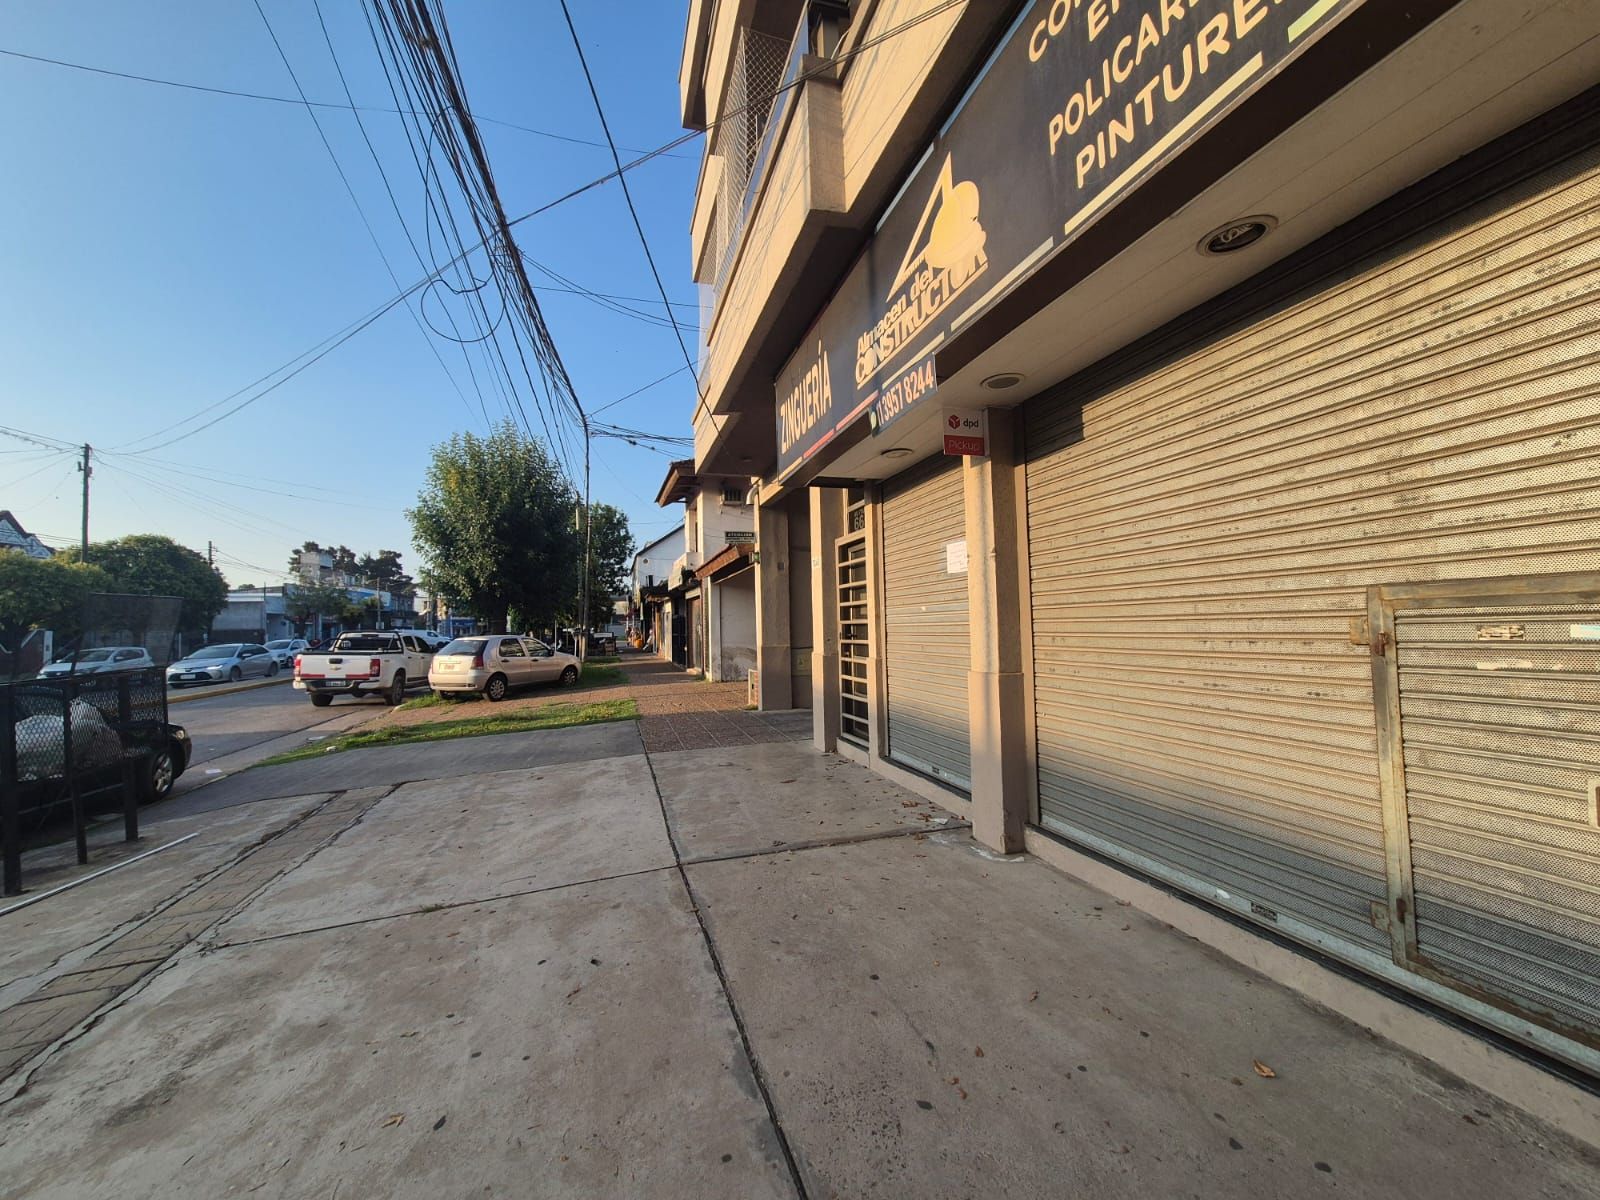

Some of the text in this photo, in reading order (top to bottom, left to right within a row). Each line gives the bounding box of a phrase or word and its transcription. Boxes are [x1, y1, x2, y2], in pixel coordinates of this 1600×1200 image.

[1029, 0, 1081, 62] CO
[1087, 0, 1120, 42] E
[1050, 0, 1199, 155] POLICAR
[1076, 0, 1284, 189] PINTURE
[857, 266, 934, 359] Almacen del
[780, 339, 832, 455] ZINGUERÍA
[903, 360, 934, 404] 8244
[963, 418, 979, 430] dpd
